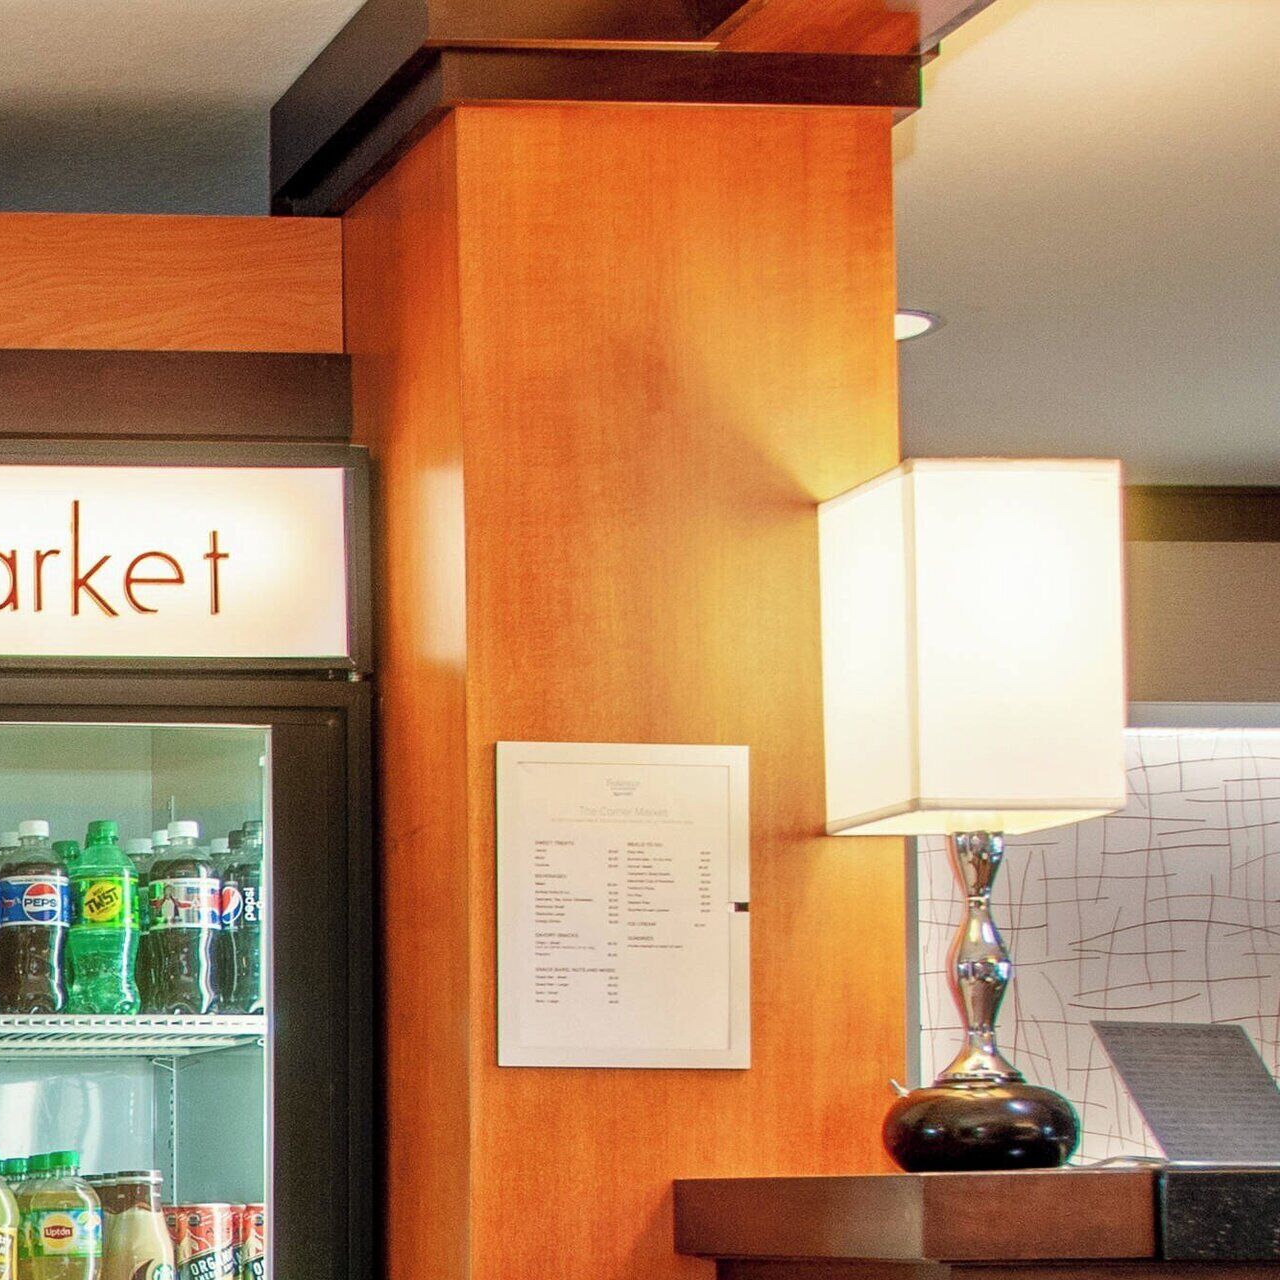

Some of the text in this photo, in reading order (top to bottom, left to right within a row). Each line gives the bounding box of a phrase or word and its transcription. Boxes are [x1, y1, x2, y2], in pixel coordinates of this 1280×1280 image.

[85, 887, 119, 913] TWIST
[243, 887, 255, 922] pepsi
[45, 1228, 71, 1238] Lipton
